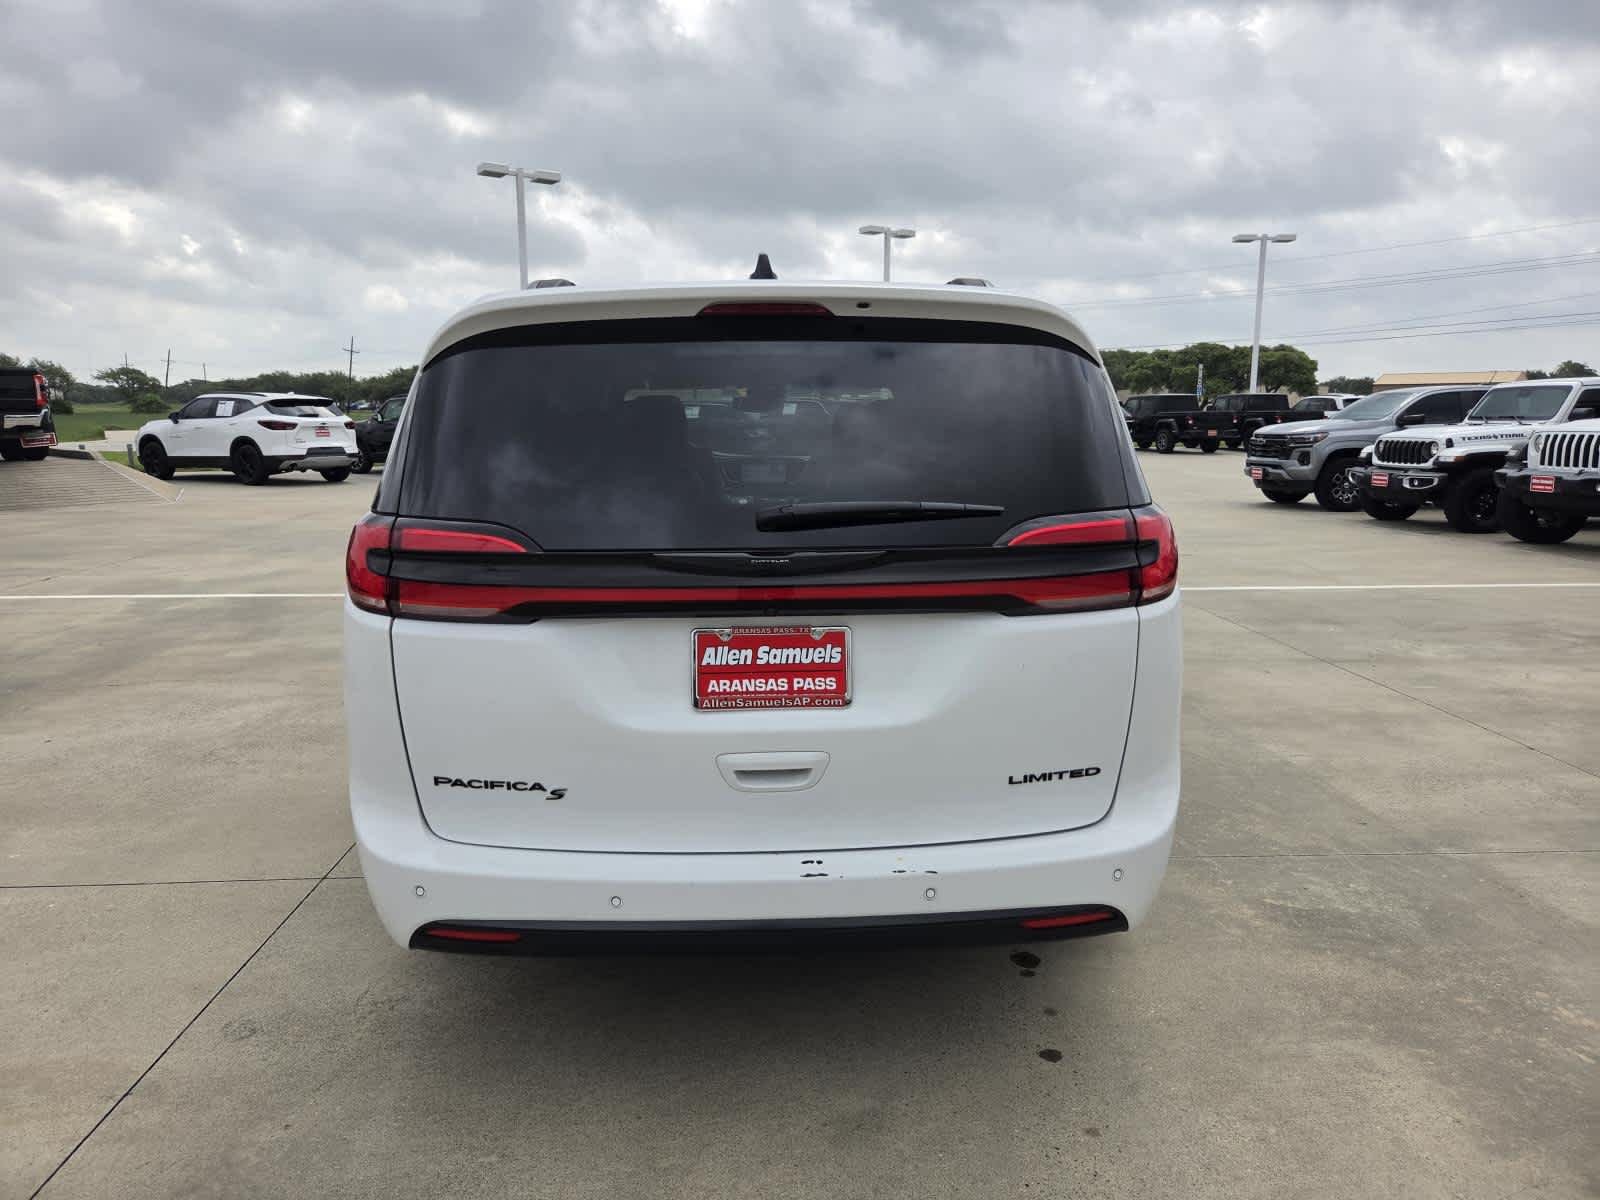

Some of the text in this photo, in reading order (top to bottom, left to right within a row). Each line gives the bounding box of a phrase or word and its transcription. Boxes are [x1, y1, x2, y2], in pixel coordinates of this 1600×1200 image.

[701, 644, 842, 666] Allen Samuels
[707, 677, 837, 693] ARANSAS PASS
[702, 698, 843, 709] AllenSamuelsAP.com
[1008, 767, 1102, 785] LIMITED
[433, 776, 568, 801] PACIFICA S
